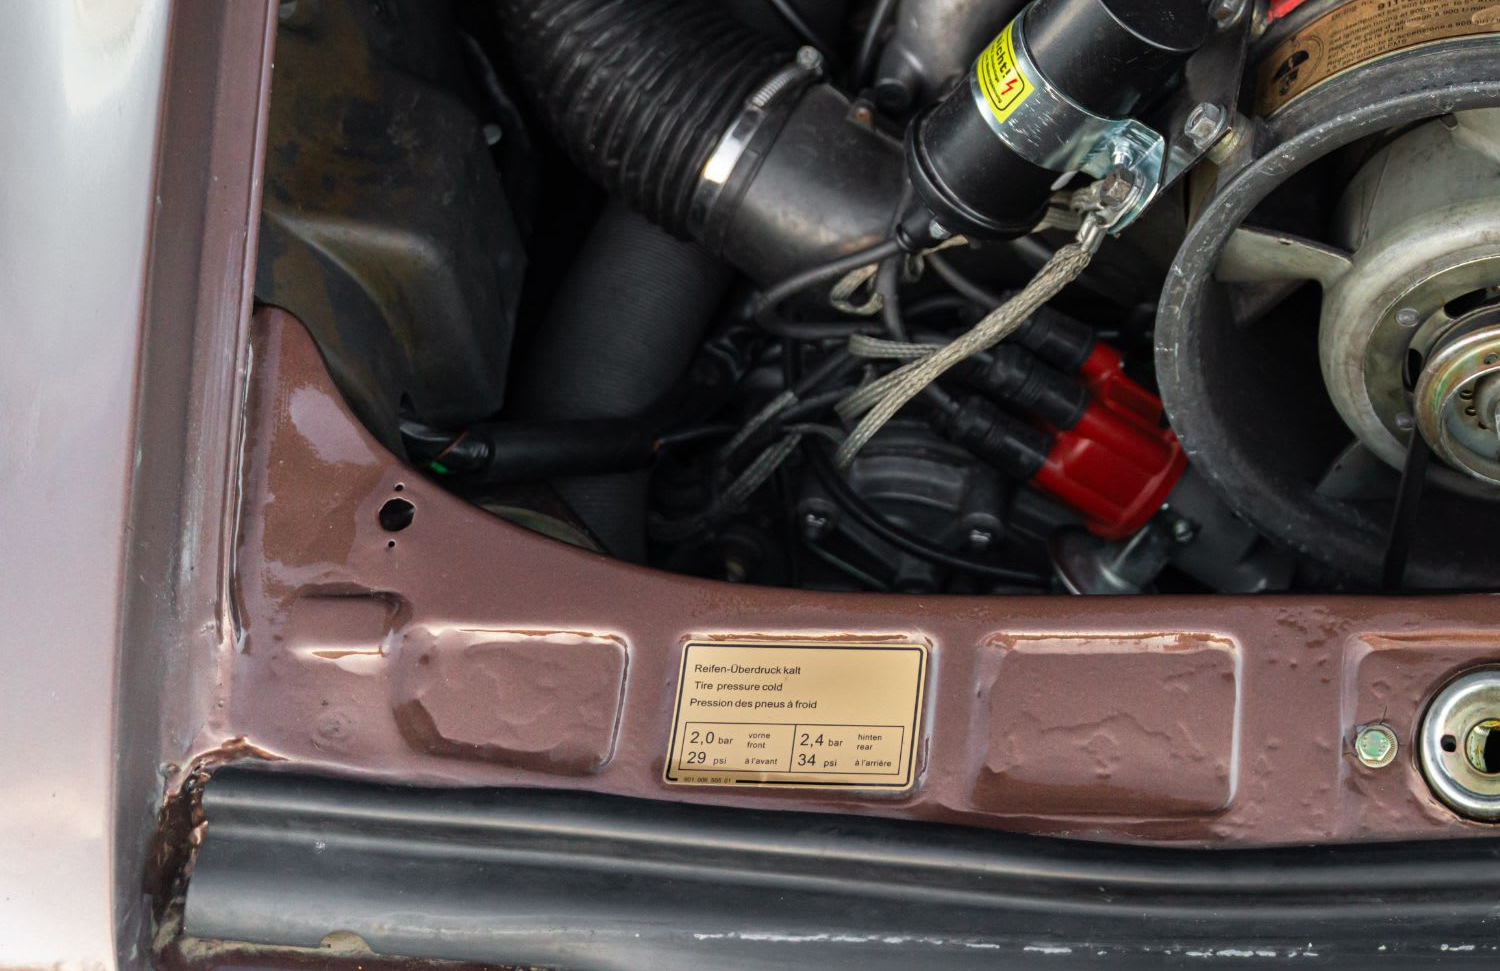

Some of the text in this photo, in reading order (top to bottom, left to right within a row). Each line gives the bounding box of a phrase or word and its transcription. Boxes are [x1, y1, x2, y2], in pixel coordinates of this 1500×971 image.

[694, 663, 801, 674] Reifen-Überdruck kalt
[695, 682, 783, 691] Tire pressure cold
[690, 698, 817, 709] Pression des pneus à froid
[690, 731, 733, 745] 2,0 bar
[800, 733, 843, 747] 2,4 bar
[747, 741, 766, 749] front
[687, 752, 706, 764] 29
[713, 757, 727, 766] psi
[798, 753, 815, 766] 34
[824, 759, 837, 768] psi
